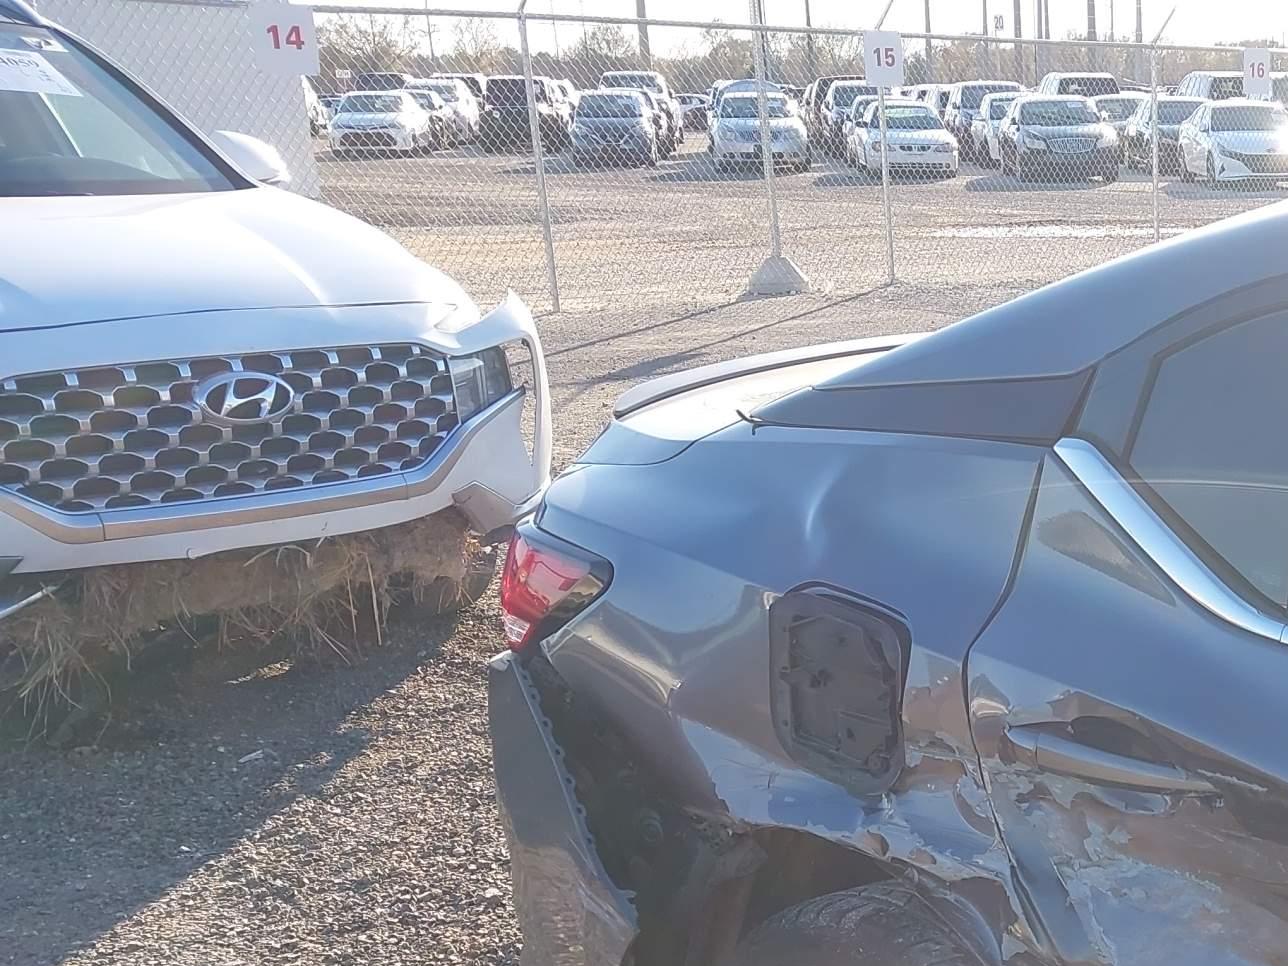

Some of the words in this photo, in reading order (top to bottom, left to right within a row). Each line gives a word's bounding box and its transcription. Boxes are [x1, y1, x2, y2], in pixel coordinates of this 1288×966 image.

[266, 25, 304, 50] 14
[873, 47, 896, 67] 15
[1249, 62, 1265, 78] 16
